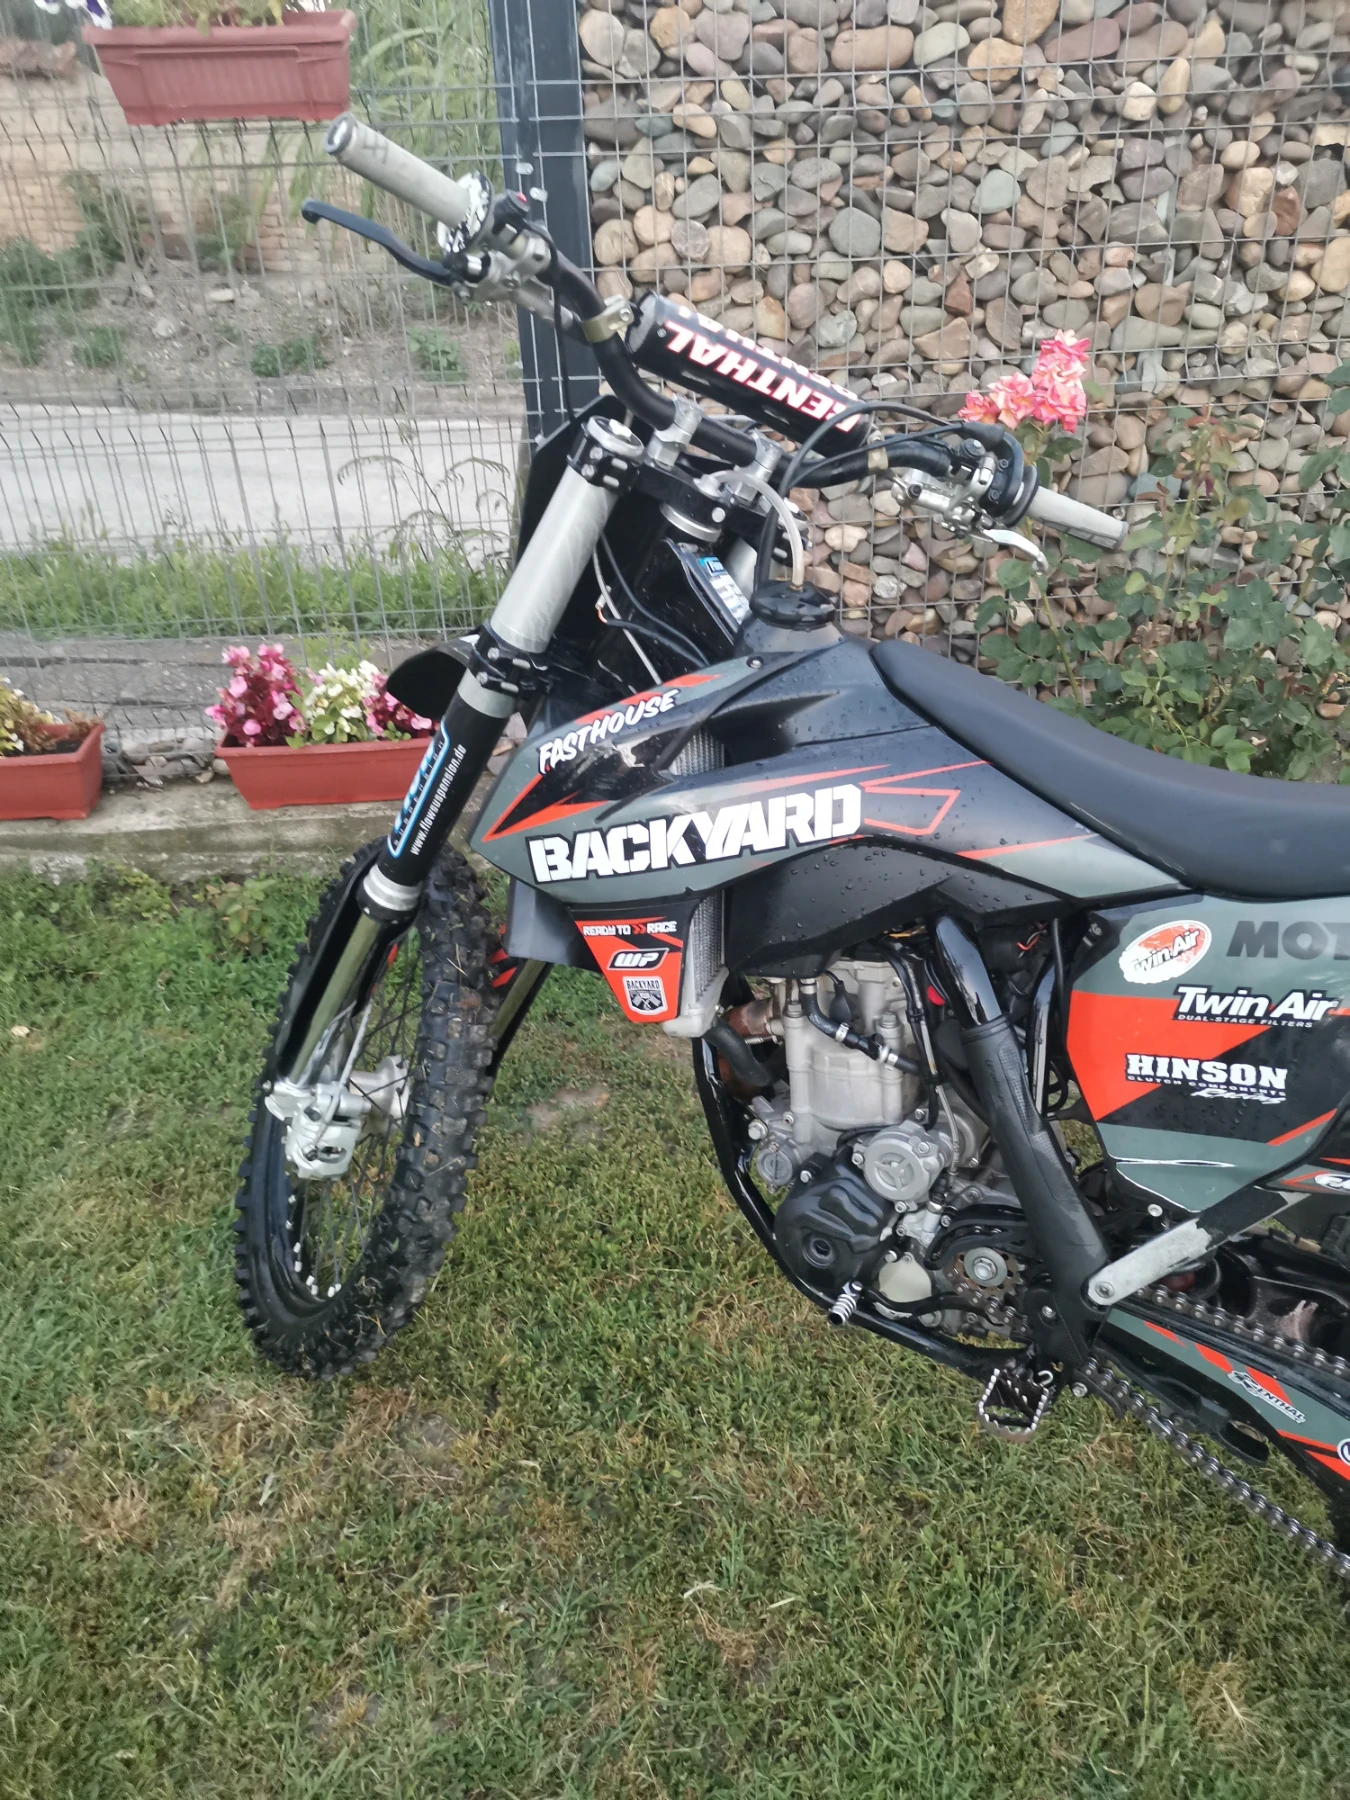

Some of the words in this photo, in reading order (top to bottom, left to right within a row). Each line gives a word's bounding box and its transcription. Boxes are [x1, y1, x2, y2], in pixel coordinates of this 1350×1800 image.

[664, 320, 862, 432] RENTHAL
[539, 689, 679, 774] FASTHOUSE
[529, 783, 862, 884] BACKYARD
[582, 924, 616, 936] READY
[618, 924, 631, 936] TO
[647, 921, 678, 934] RACE
[1172, 928, 1201, 958] Air
[613, 952, 660, 968] WP
[626, 979, 660, 990] BACKYARD
[1176, 986, 1271, 1018] Twin
[1269, 992, 1337, 1021] Air
[1177, 1014, 1256, 1025] DUAL-STAGE
[1260, 1019, 1313, 1029] FILTERS
[1127, 1054, 1288, 1090] HINSON
[1128, 1075, 1181, 1086] CLUTCH
[1188, 1081, 1286, 1097] COMPONENTS
[1230, 1370, 1305, 1420] RENTHAL
